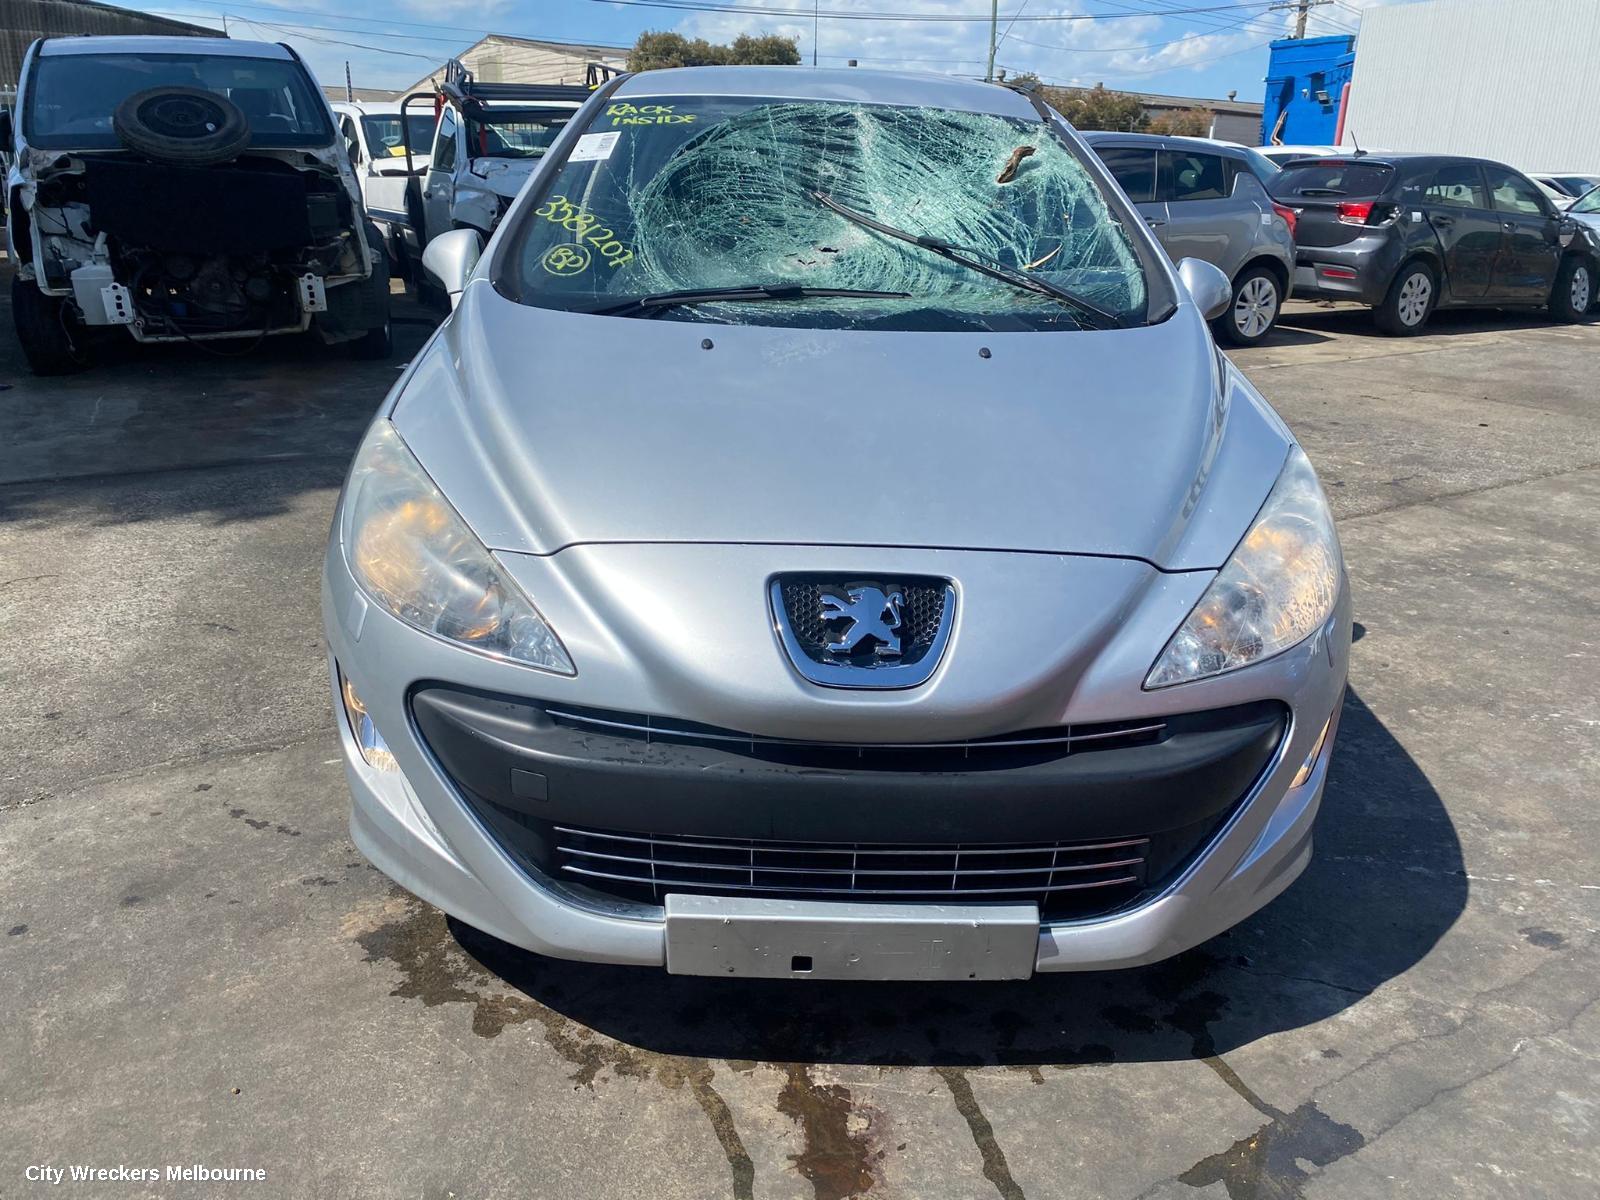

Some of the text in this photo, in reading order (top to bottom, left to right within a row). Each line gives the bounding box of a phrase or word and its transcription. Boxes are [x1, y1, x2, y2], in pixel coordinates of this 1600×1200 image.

[606, 102, 676, 116] RACK
[611, 114, 698, 126] INSIDE
[534, 195, 634, 269] 3581207
